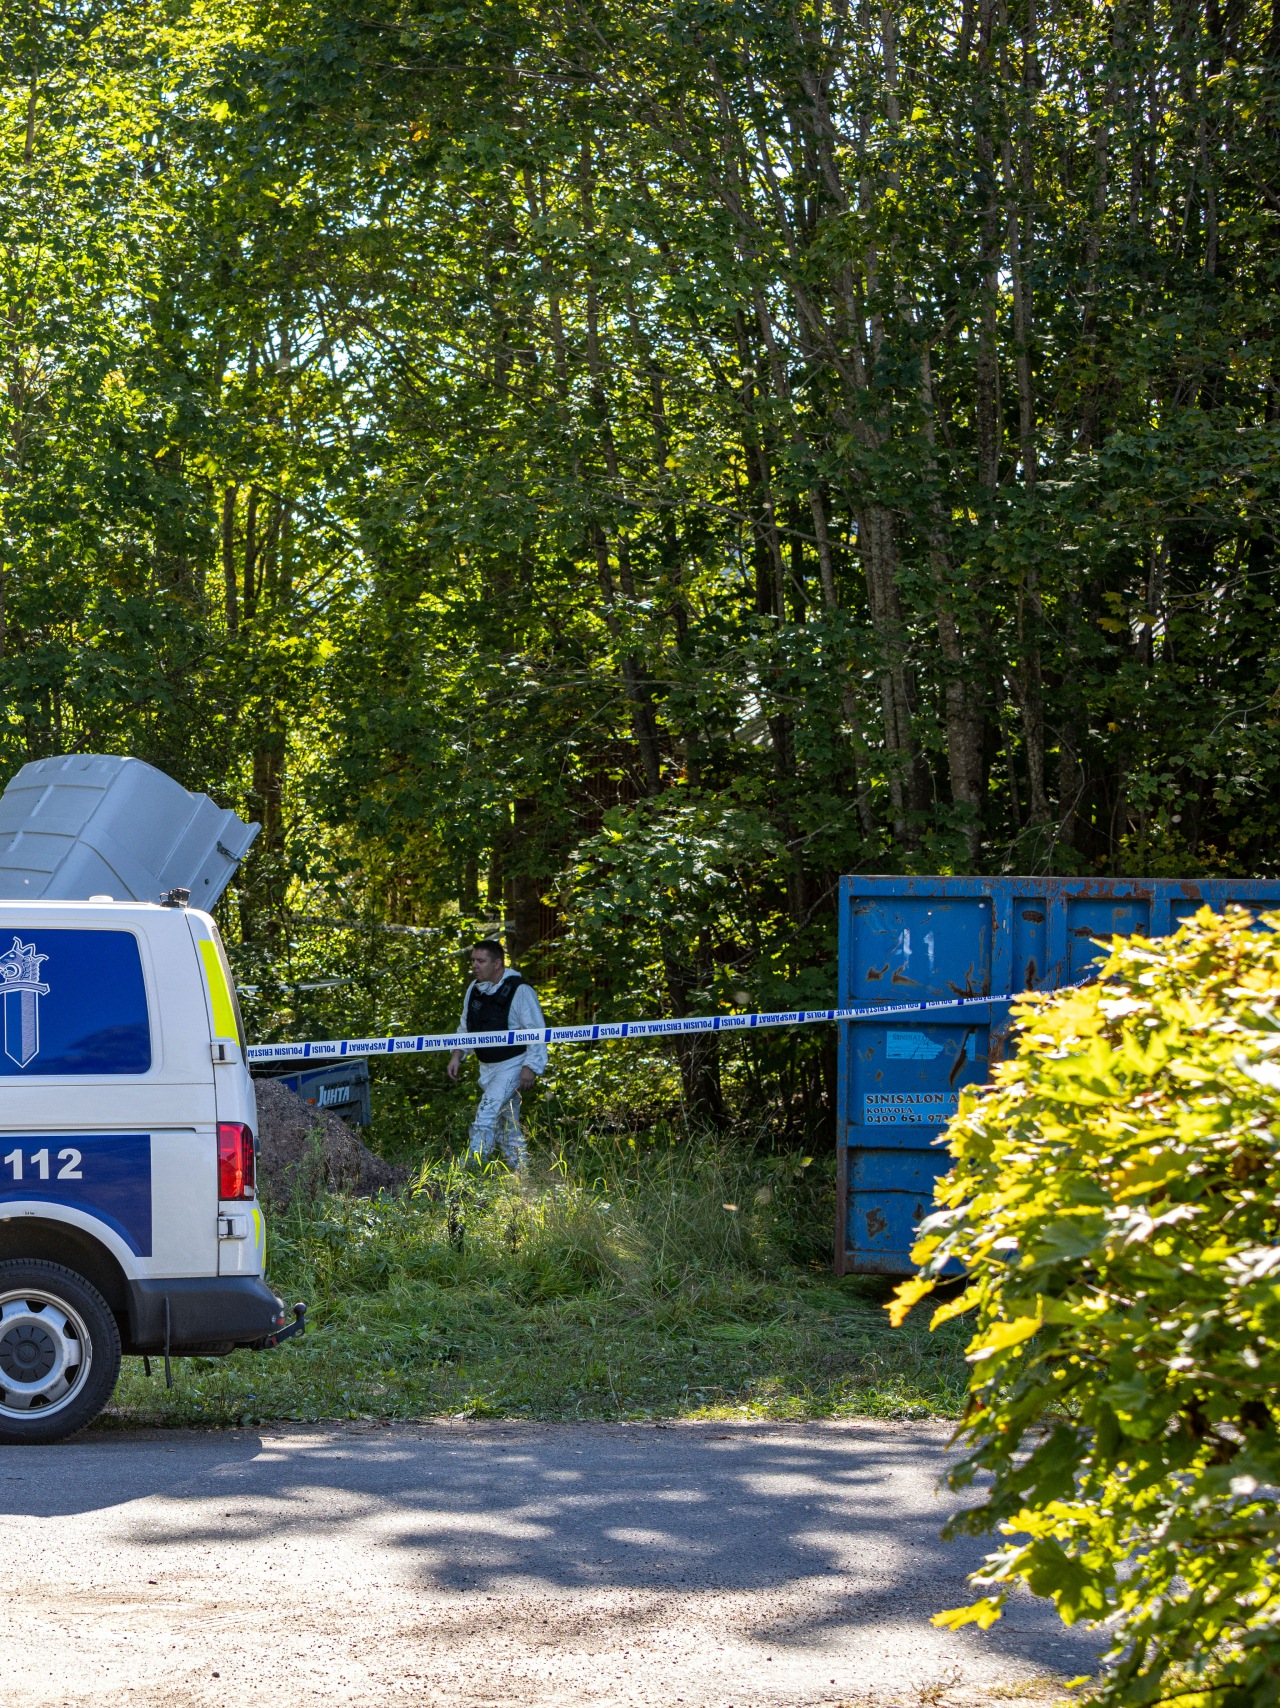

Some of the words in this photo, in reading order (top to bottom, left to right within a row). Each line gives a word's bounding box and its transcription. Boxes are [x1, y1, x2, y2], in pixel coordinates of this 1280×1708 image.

[758, 1013, 797, 1024] AVSPÄRRAT
[806, 1011, 826, 1019] POLIS
[683, 1020, 712, 1029] POLIISIN
[721, 1018, 746, 1027] POLIISI
[600, 1027, 620, 1036] POLIS
[629, 1025, 646, 1034] ALUE
[647, 1022, 682, 1033] ERISTÄMÄ
[516, 1033, 540, 1042] POLIISI
[552, 1029, 591, 1040] AVSPÄRRAT
[424, 1039, 441, 1047] ALUE
[442, 1037, 477, 1048] ERISTÄMÄ
[478, 1035, 507, 1044] POLIISIN
[312, 1045, 336, 1054] POLIISI
[348, 1042, 386, 1053] AVSPÄRRAT
[395, 1041, 415, 1049] POLIS
[274, 1046, 303, 1056] POLIISIN
[317, 1085, 350, 1107] JUHTA
[866, 1094, 944, 1104] SINISALON
[866, 1115, 897, 1124] 0400
[901, 1114, 922, 1123] 651
[4, 1148, 83, 1180] 112
